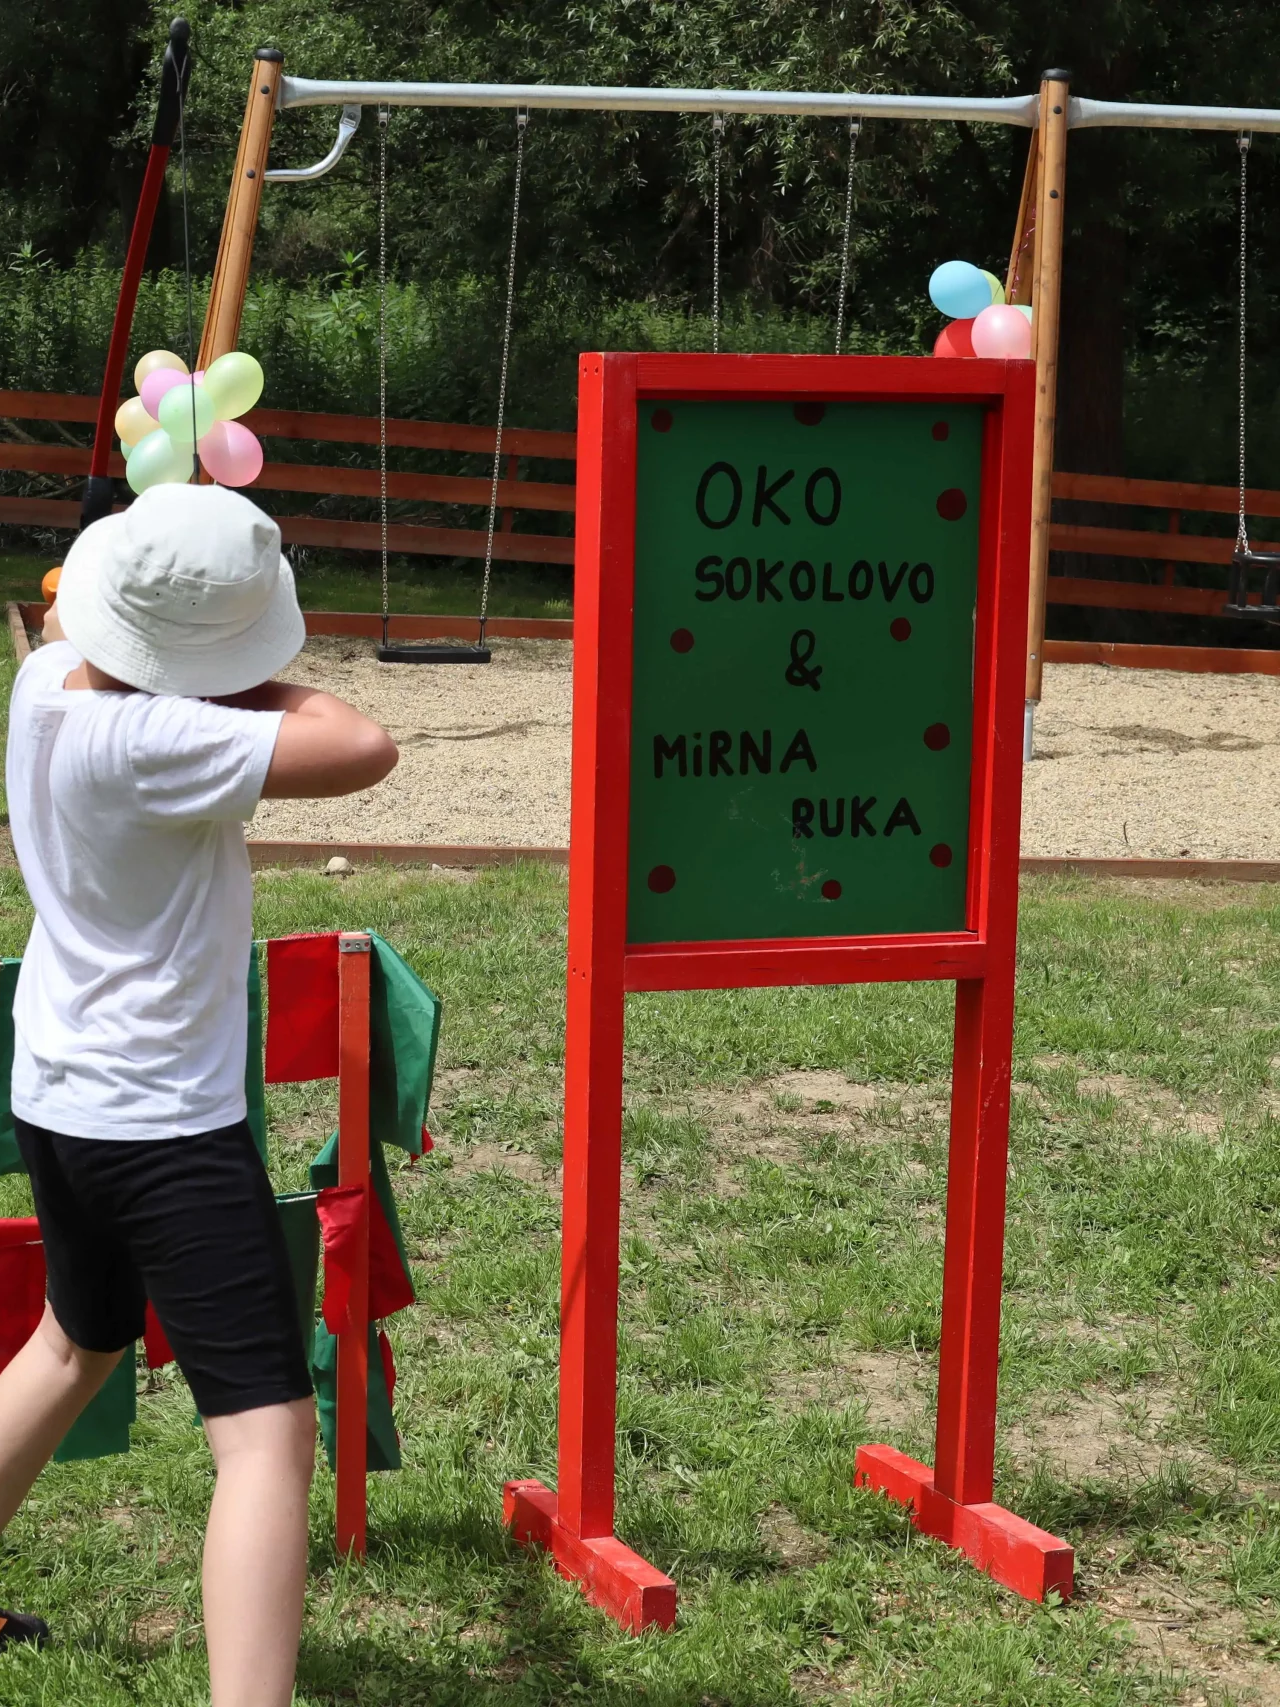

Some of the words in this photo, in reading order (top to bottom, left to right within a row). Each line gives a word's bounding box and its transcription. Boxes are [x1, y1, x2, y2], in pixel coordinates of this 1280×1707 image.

[694, 461, 842, 530] OKO
[693, 555, 935, 604] SOKOLOVO
[784, 628, 823, 692] &
[653, 728, 818, 779] MiRNA
[791, 795, 922, 839] RUKA
